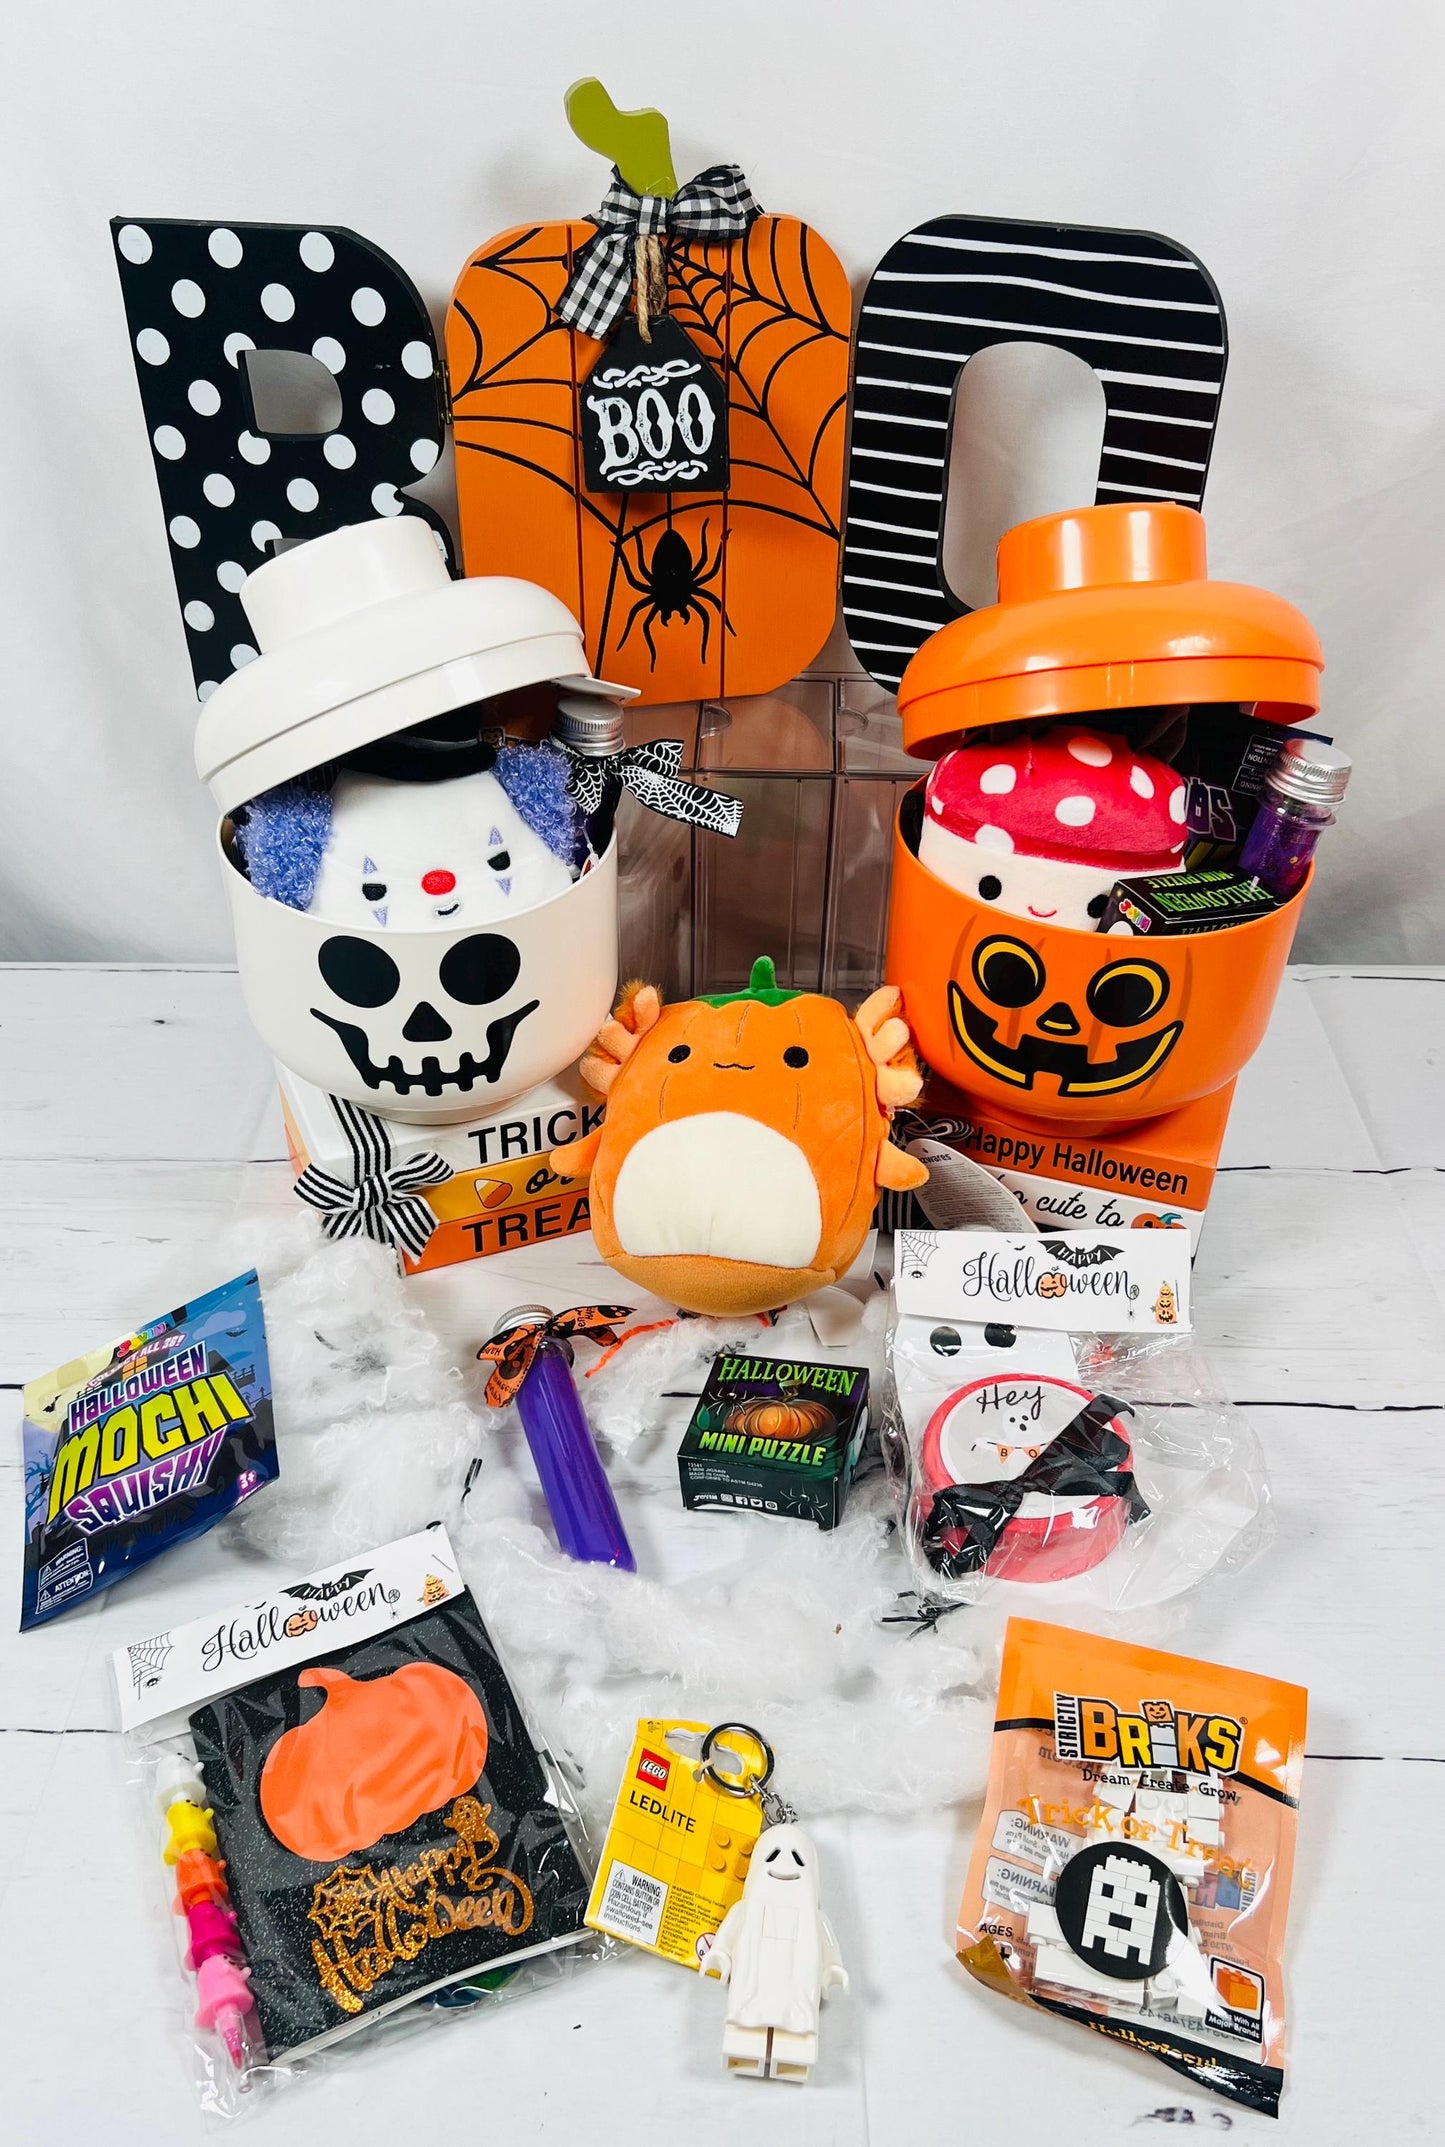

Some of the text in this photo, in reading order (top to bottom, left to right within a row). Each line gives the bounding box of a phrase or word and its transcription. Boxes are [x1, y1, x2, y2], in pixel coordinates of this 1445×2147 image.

[586, 383, 717, 475] BOO
[1150, 880, 1275, 913] HALLOWEEN
[468, 1103, 606, 1164] TRICK
[963, 1126, 1045, 1170] Happy
[1052, 1143, 1189, 1195] Halloween
[462, 1197, 591, 1253] TREA
[1036, 1191, 1089, 1221] cute
[1095, 1192, 1125, 1228] to
[1056, 1242, 1102, 1265] HAPPY
[962, 1251, 1130, 1302] Halloween
[717, 1357, 859, 1397] HALLOWEEN
[976, 1384, 1046, 1420] Hey
[698, 1431, 828, 1467] MINI PUZZLE
[302, 1576, 351, 1600] HAPPY
[202, 1583, 389, 1672] Halloween
[1055, 1693, 1078, 1758] STRICTLY
[640, 1760, 667, 1779] LEGO
[1082, 1768, 1130, 1786] Dream
[1139, 1774, 1190, 1793] Create
[1198, 1782, 1238, 1801] Grow
[630, 1790, 697, 1833] LEDLITE
[1017, 1795, 1114, 1832] Trick
[1120, 1815, 1157, 1842] or
[612, 1879, 635, 1895] CONTAINS
[635, 1889, 653, 1904] BUTTON
[621, 1893, 631, 1906] CELL
[632, 1875, 662, 1898] WARNING:
[608, 1897, 641, 1917] Hazardous
[979, 1922, 1014, 1937] AGES
[1208, 2015, 1260, 2039] Major Brands
[1233, 2014, 1249, 2027] With
[1251, 2021, 1260, 2030] All
